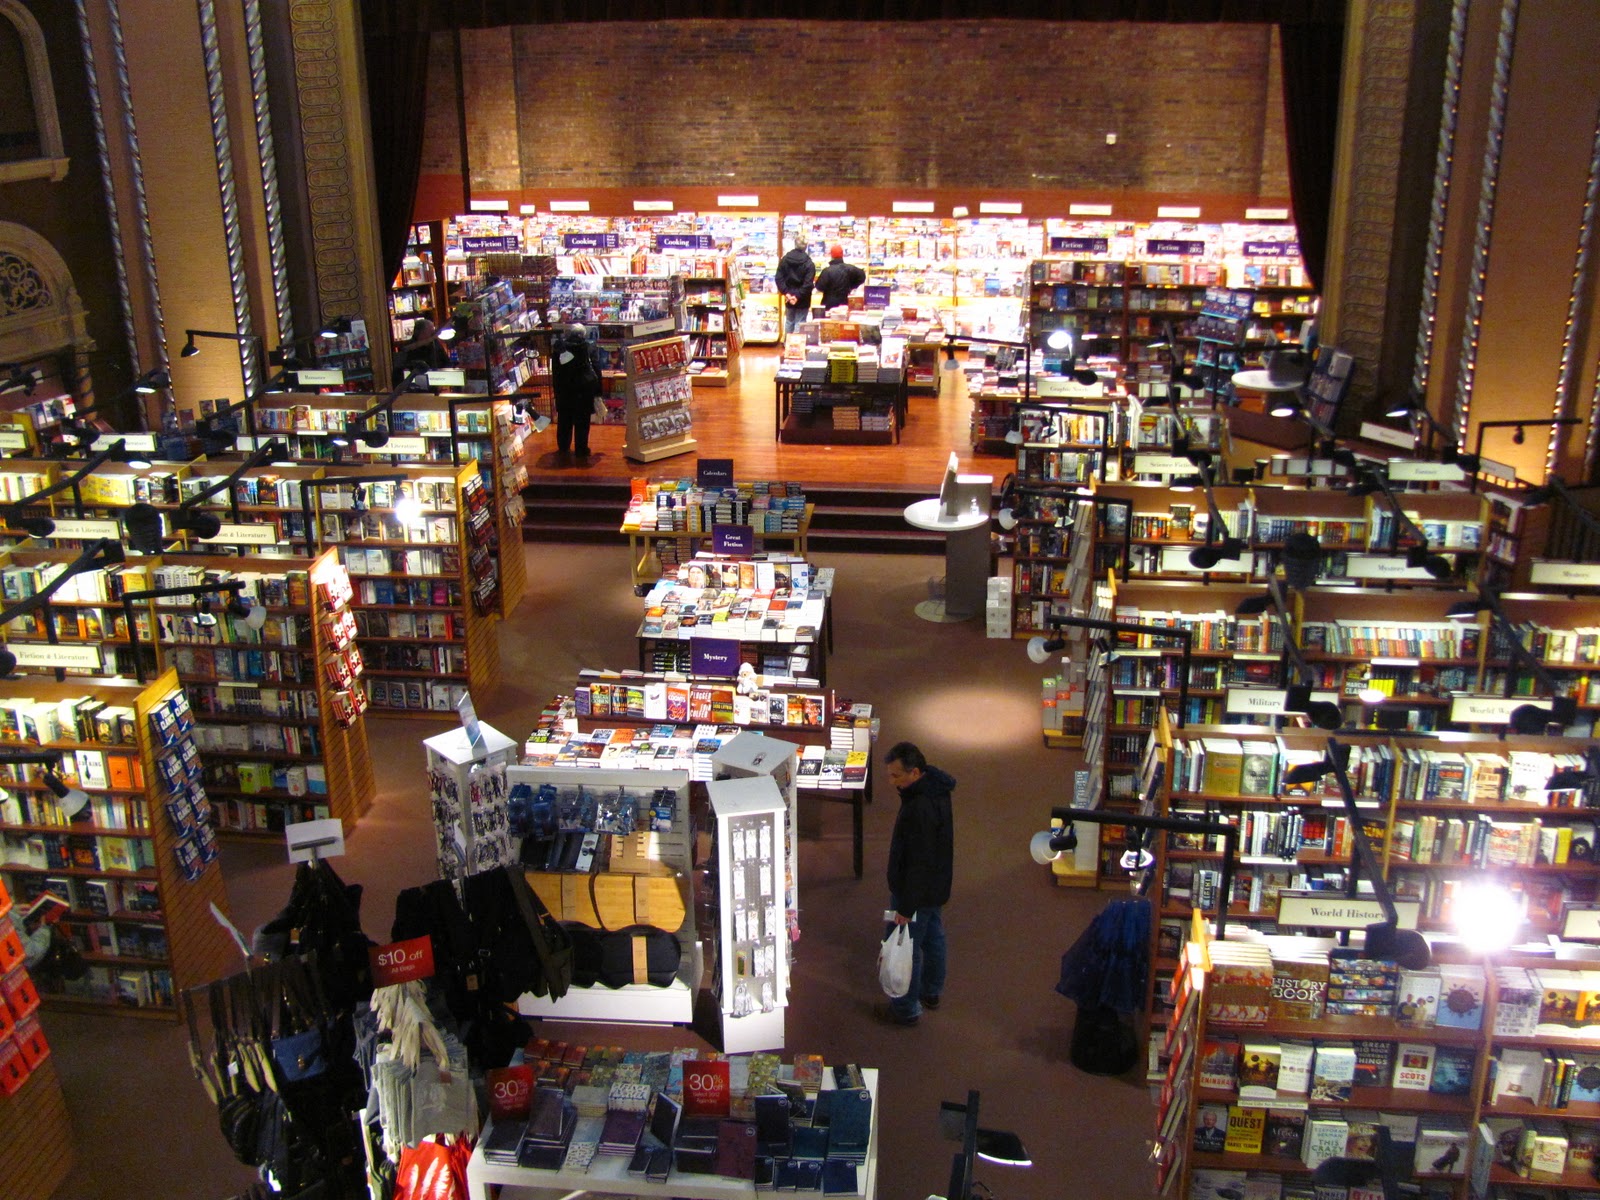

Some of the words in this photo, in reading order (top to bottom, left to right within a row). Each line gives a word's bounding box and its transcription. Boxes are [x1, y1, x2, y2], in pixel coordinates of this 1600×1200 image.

[572, 238, 597, 247] Cooking
[664, 238, 690, 247] Cooking
[1061, 241, 1083, 249] Fiction
[1157, 244, 1180, 252] Fiction
[1248, 245, 1280, 256] Biography
[20, 651, 44, 659] Fiction
[54, 652, 88, 660] Literature
[703, 653, 728, 662] Mystery
[1248, 698, 1281, 707] Military
[1469, 706, 1494, 714] World
[1311, 907, 1343, 917] World
[1346, 908, 1385, 919] History
[378, 949, 406, 966] $10
[409, 949, 424, 961] off
[1361, 1041, 1391, 1049] GREAT
[1400, 1072, 1426, 1080] SCOTS
[1230, 1116, 1262, 1129] QUEST
